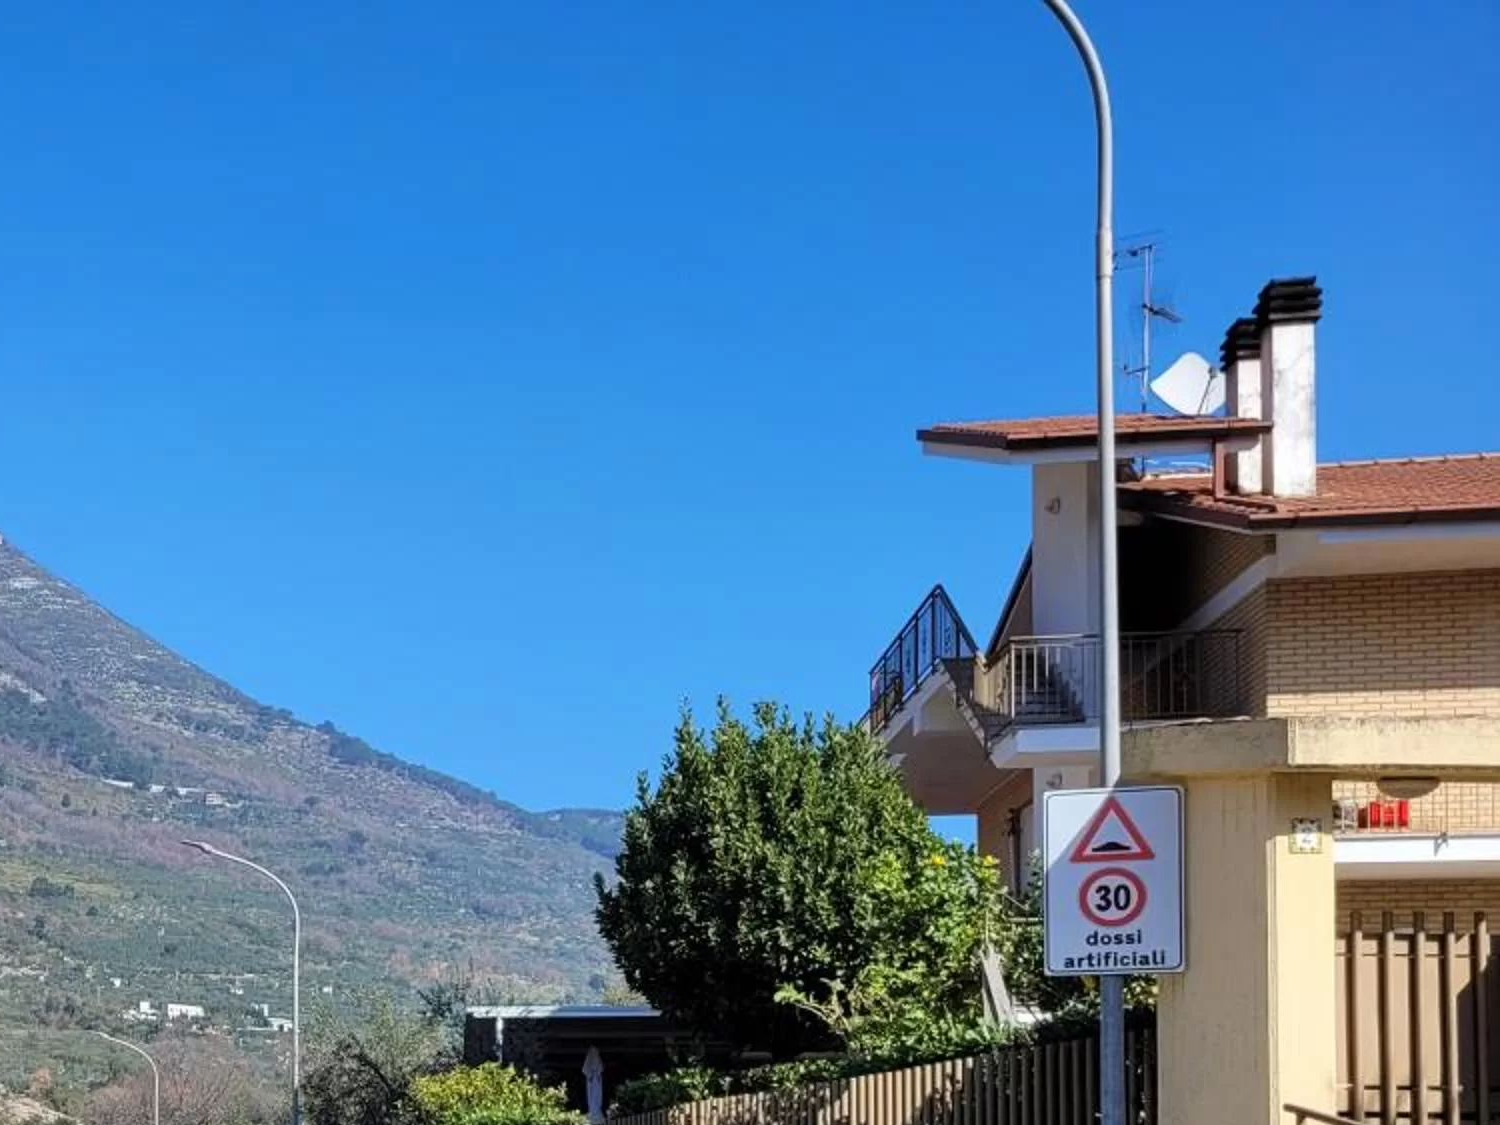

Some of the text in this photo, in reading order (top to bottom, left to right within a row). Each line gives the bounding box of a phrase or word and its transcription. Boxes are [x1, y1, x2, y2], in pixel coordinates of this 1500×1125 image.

[1095, 884, 1131, 912] 30
[1085, 929, 1142, 946] dossi
[1063, 949, 1166, 968] artificiali
